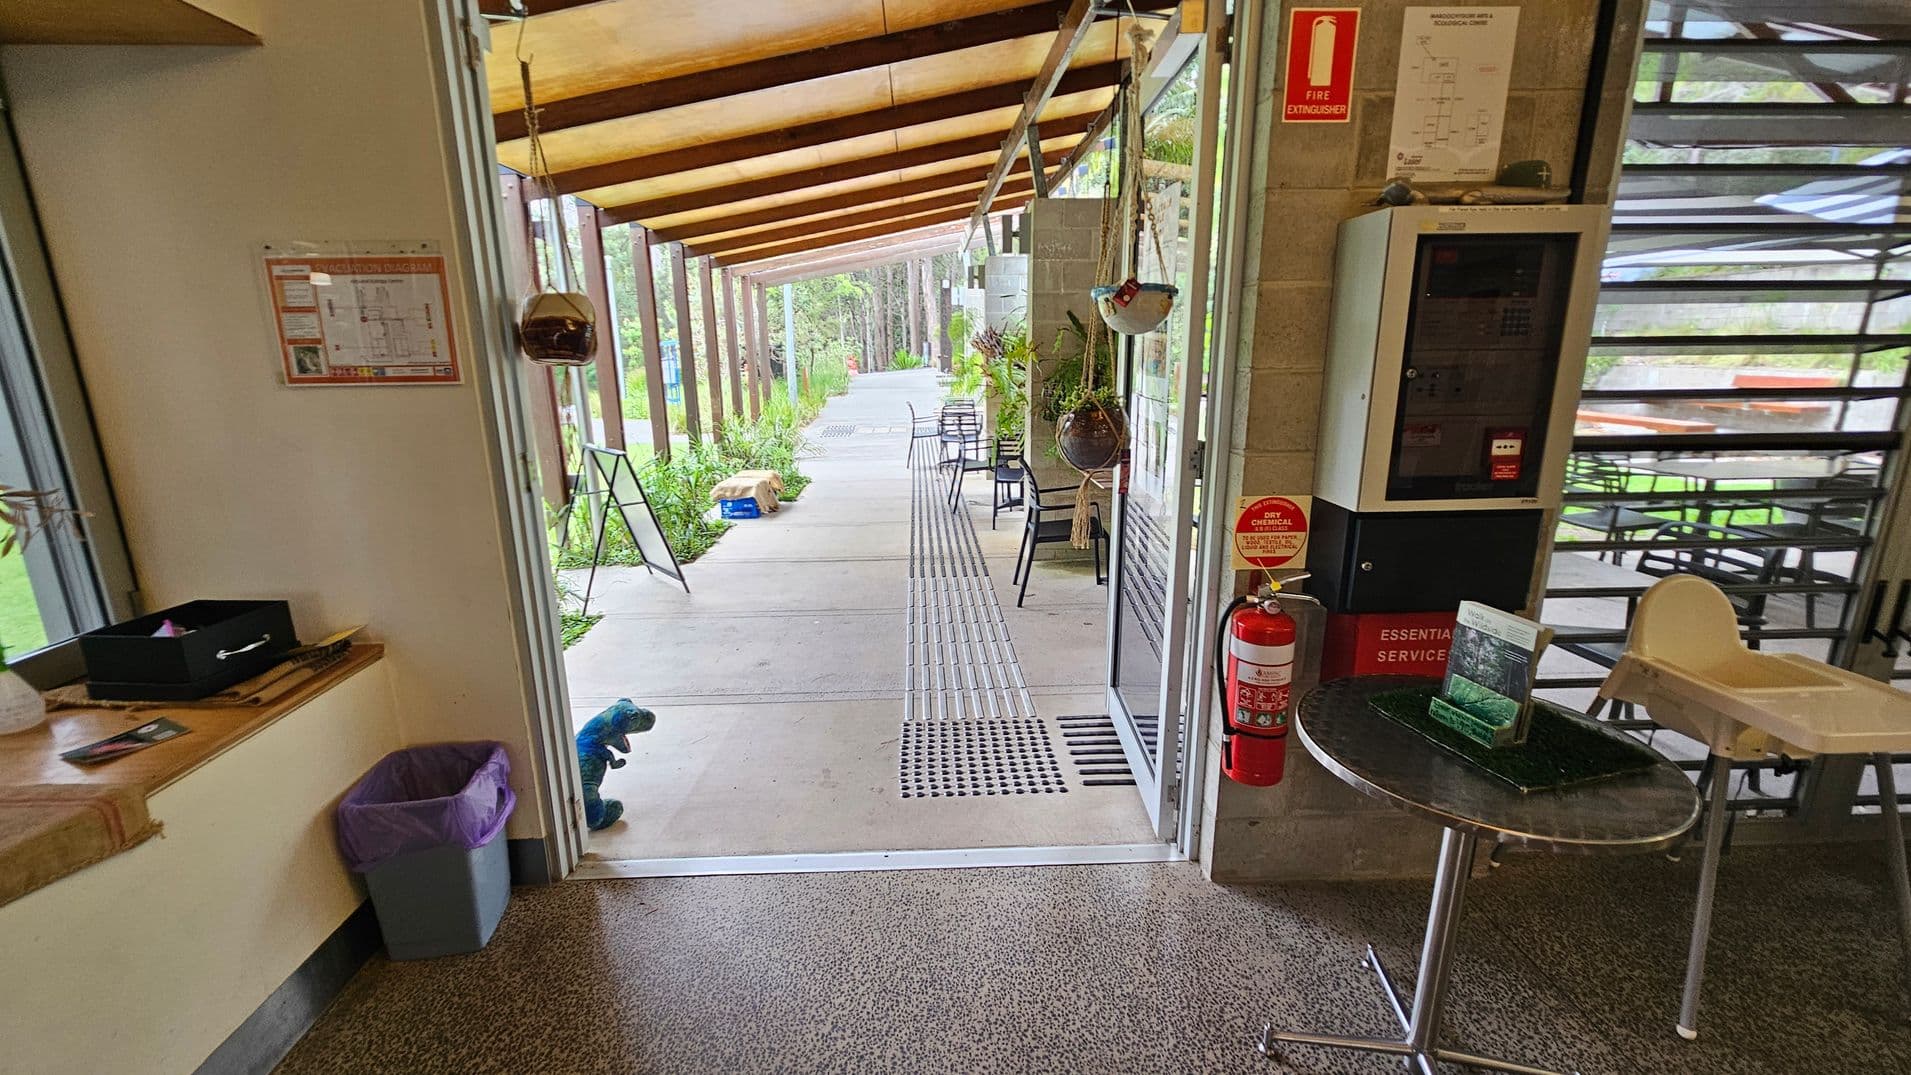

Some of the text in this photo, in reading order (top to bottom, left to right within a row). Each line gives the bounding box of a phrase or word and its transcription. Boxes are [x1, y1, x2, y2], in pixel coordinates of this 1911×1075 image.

[1306, 90, 1331, 100] FIRE
[1287, 104, 1346, 114] EXTINGUISHER
[315, 263, 381, 273] EVACUATION
[384, 263, 433, 273] DIAGRAM
[1380, 628, 1453, 641] ESSENTIA
[1377, 649, 1447, 662] SERVICE
